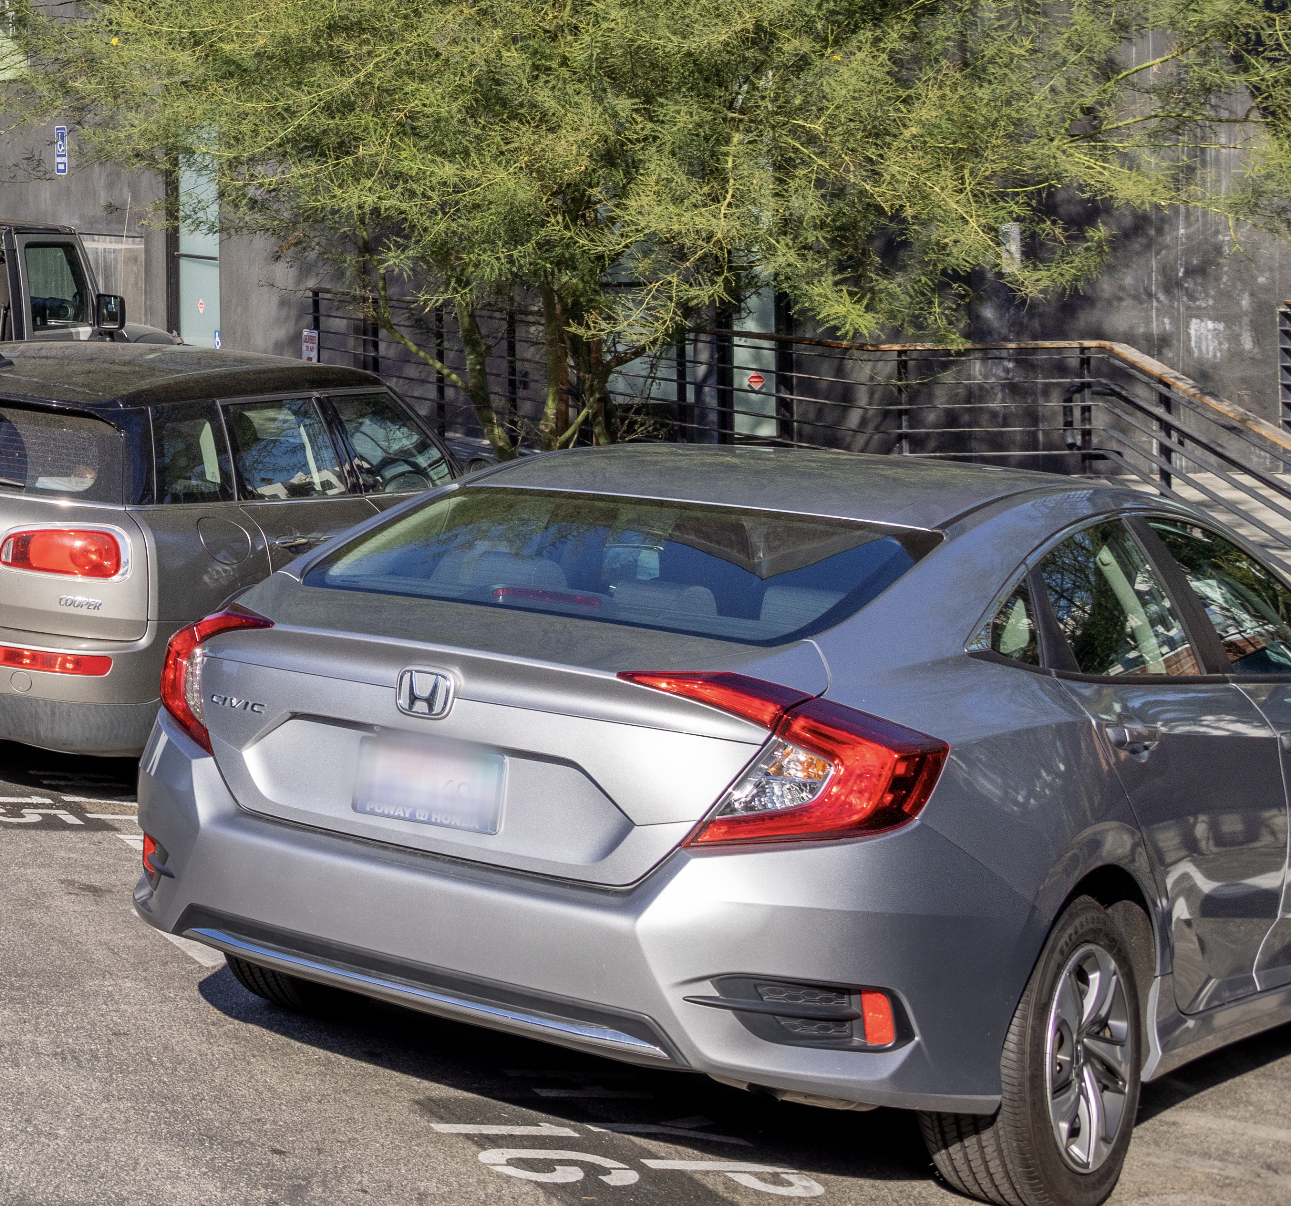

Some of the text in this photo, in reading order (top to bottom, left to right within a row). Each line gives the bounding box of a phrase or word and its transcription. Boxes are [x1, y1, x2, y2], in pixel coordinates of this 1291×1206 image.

[57, 595, 103, 612] COOPER
[208, 693, 267, 715] CIVIC
[366, 801, 480, 830] POWAY HONDA
[428, 1122, 641, 1187] 16
